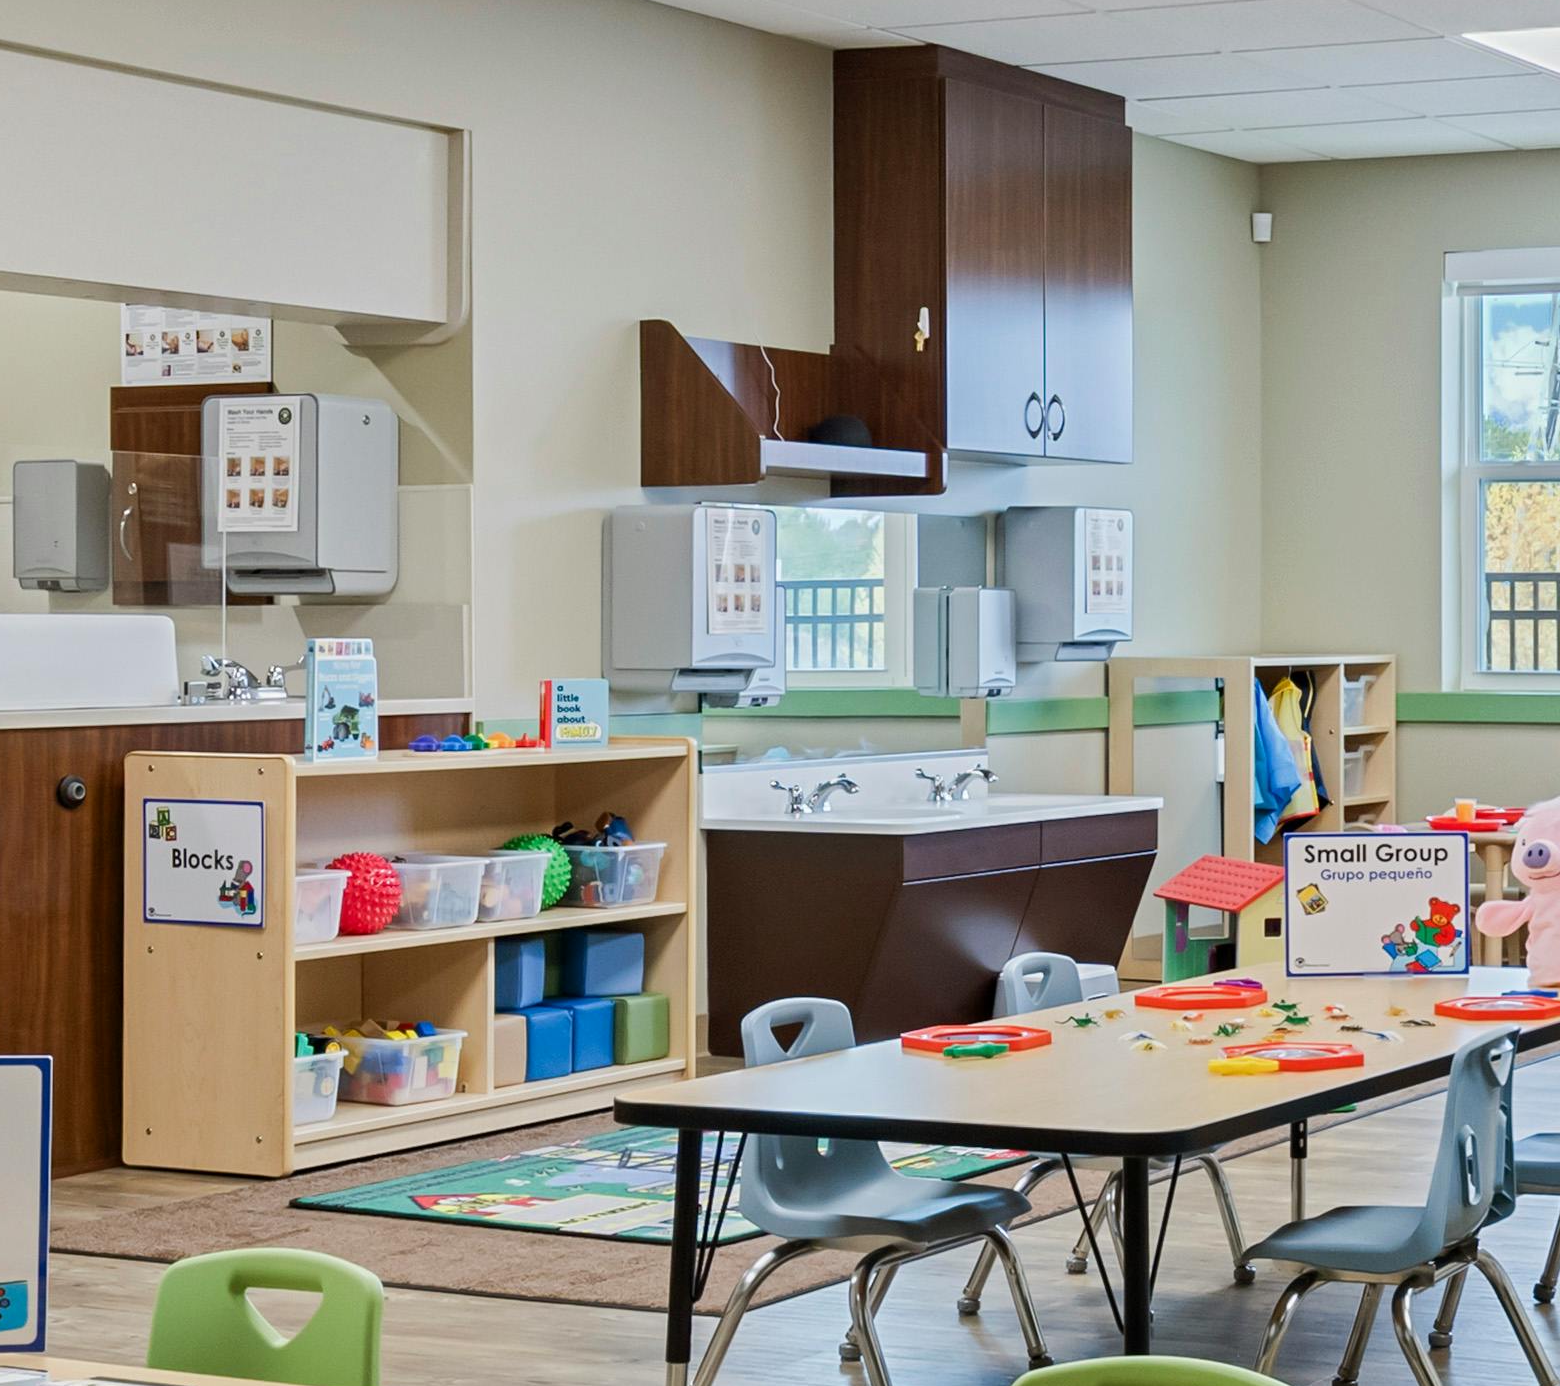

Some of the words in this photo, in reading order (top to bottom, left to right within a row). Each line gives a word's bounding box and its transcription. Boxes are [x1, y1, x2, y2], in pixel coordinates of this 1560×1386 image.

[557, 694, 579, 702] little
[557, 715, 585, 723] about
[172, 848, 233, 870] Blocks
[1304, 844, 1367, 863] Small
[1375, 843, 1448, 865] Group
[1320, 869, 1364, 882] Grupo
[1369, 867, 1433, 882] pequeño
